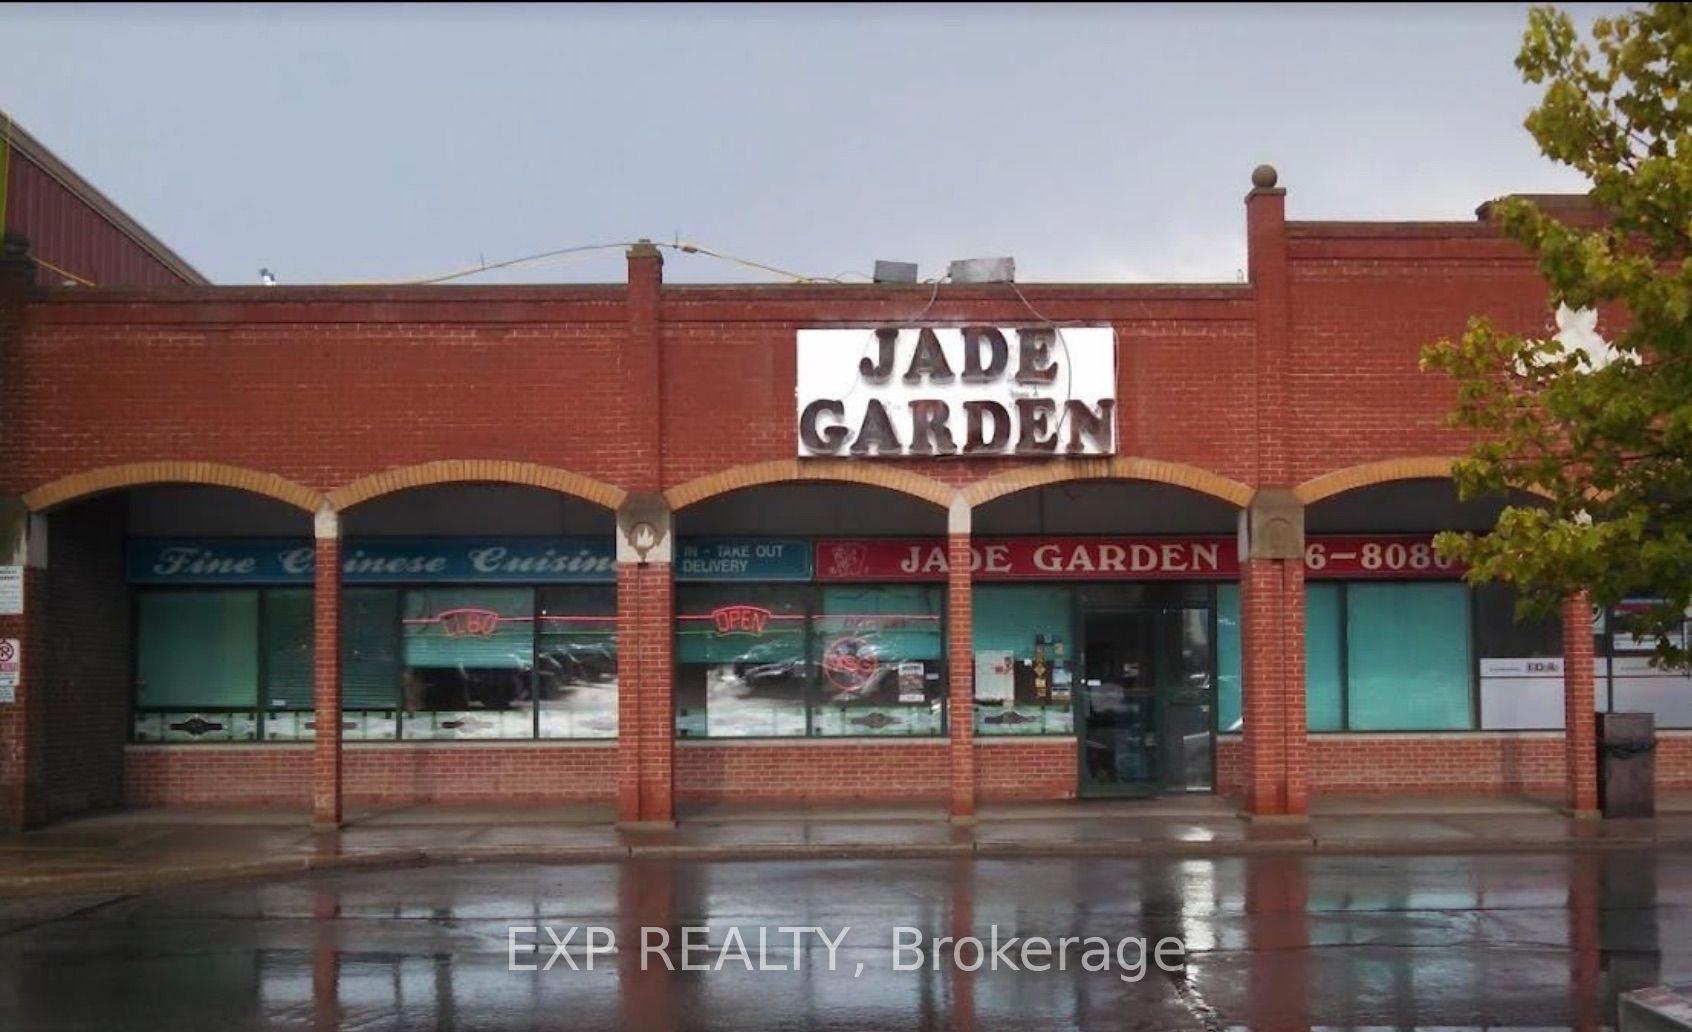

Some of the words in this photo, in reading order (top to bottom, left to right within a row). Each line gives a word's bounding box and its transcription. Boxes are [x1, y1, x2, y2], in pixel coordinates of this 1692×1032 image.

[859, 326, 1059, 384] JADE
[800, 398, 1115, 456] GARDEN
[153, 547, 256, 575] Fine
[279, 547, 447, 574] Cinese
[468, 546, 618, 572] Cuisin
[717, 545, 751, 557] TAKE
[756, 544, 784, 557] OUT
[1033, 544, 1218, 571] GARDEN
[683, 560, 748, 572] DELIVERY
[715, 611, 767, 633] OPEN
